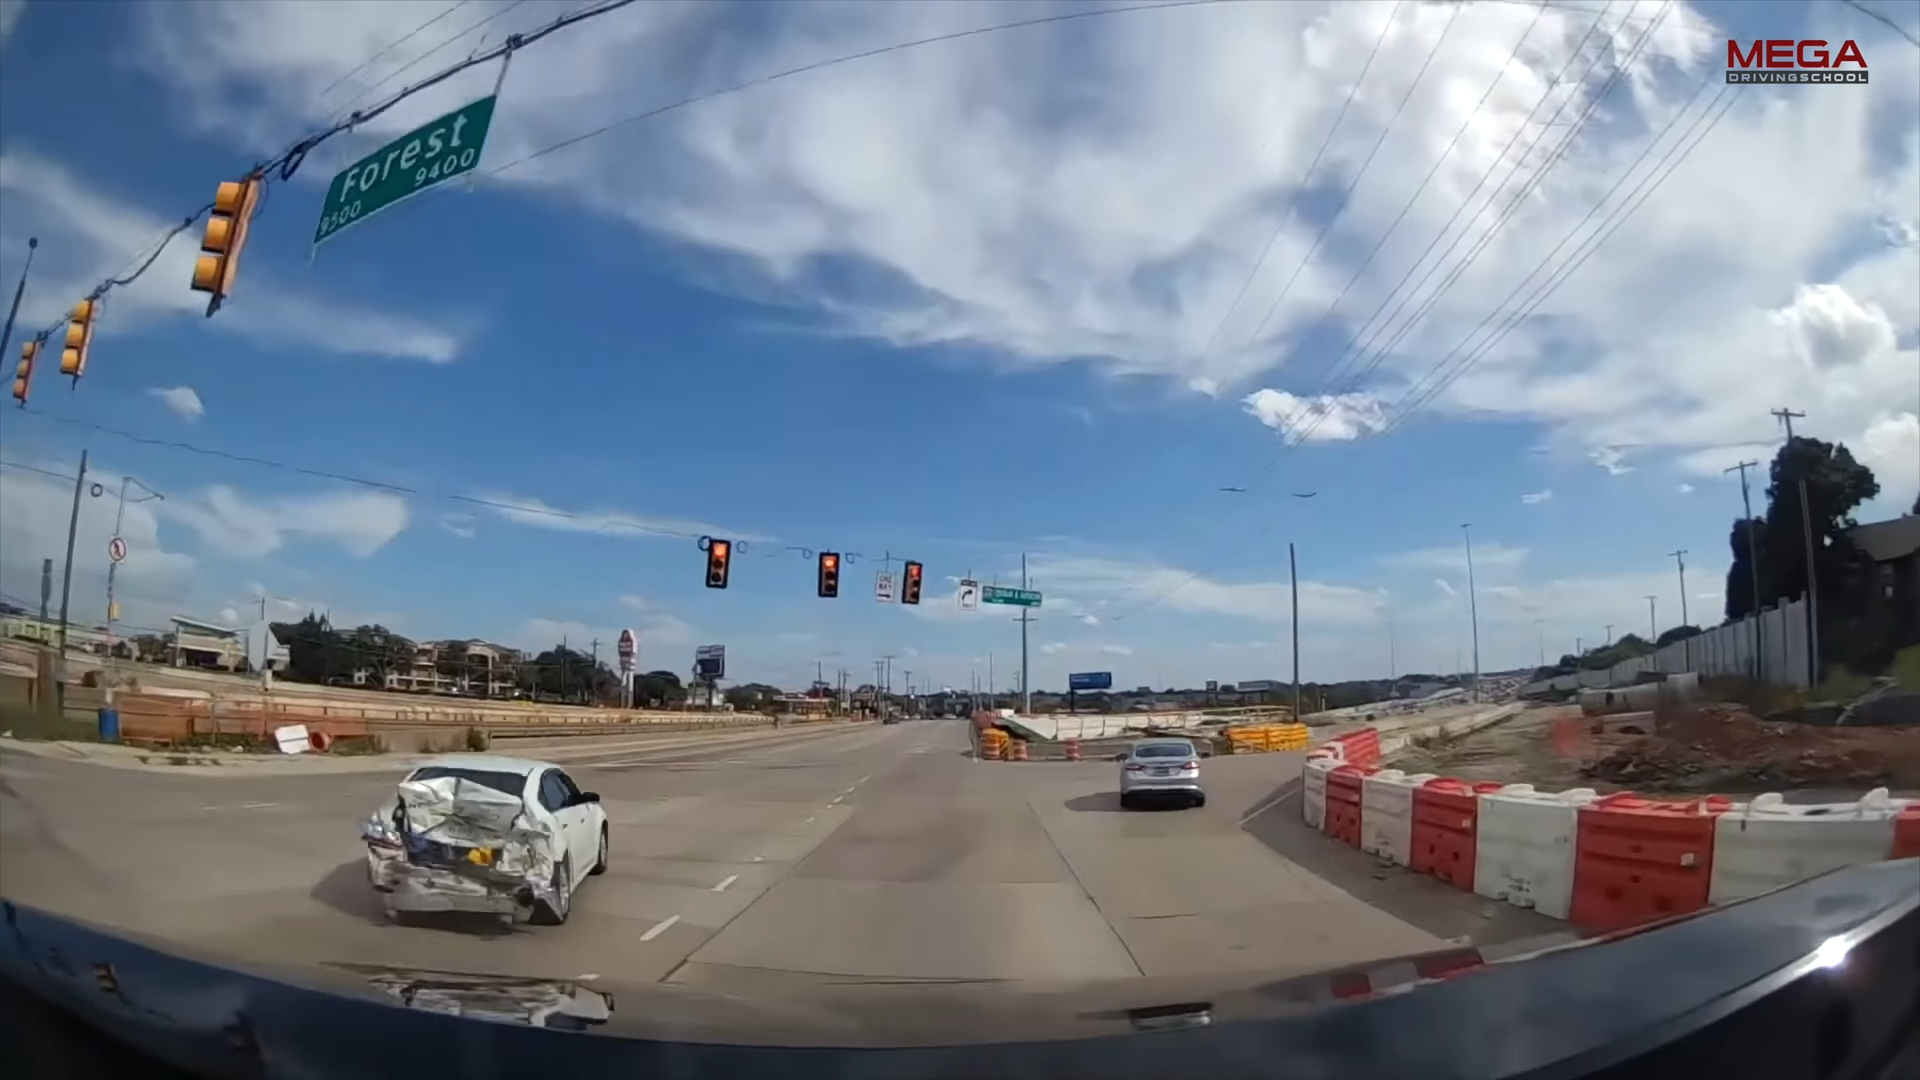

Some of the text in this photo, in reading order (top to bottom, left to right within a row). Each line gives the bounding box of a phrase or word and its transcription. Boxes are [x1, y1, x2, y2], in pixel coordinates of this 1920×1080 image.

[340, 114, 467, 203] Forest
[414, 148, 475, 187] 9400
[319, 200, 361, 235] 9500
